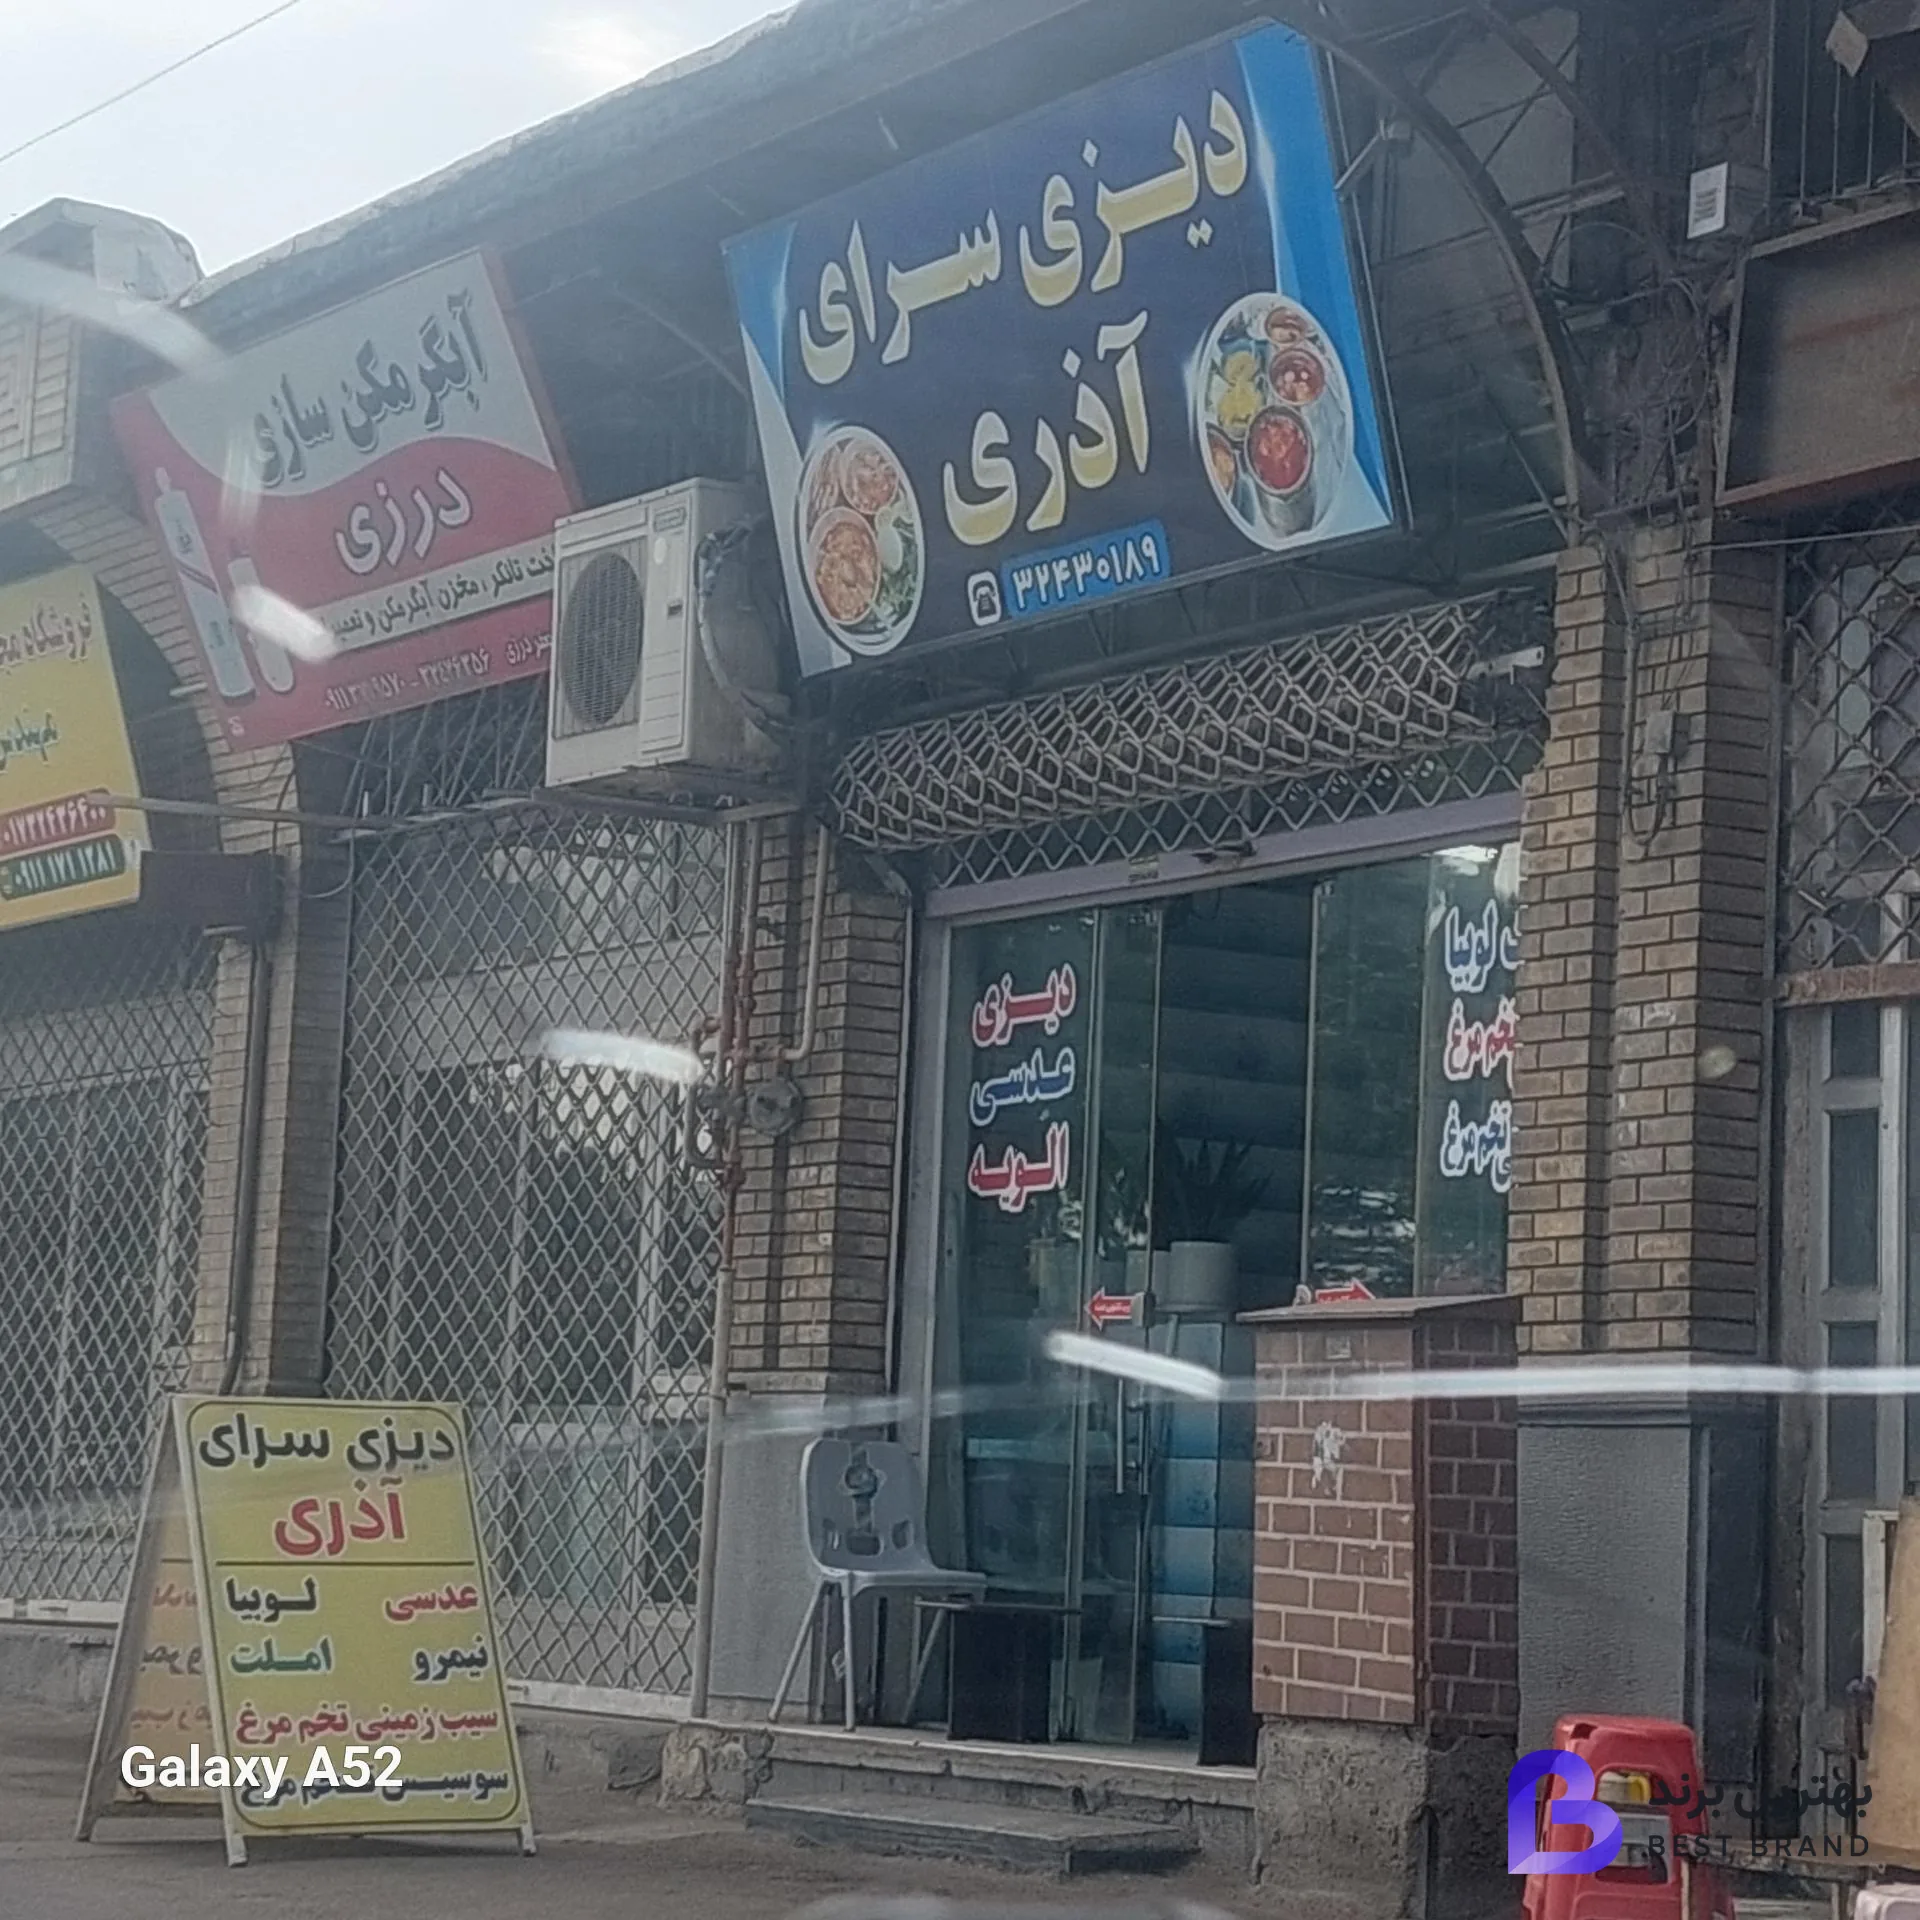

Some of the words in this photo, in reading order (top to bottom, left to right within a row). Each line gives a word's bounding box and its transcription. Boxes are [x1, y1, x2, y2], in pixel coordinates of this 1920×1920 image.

[1019, 89, 1248, 308] دیزی
[798, 208, 1001, 385] سرای
[253, 372, 334, 488] سازی
[943, 309, 1150, 546] آذری
[335, 467, 474, 576] درزی
[526, 542, 554, 578] اخت
[1011, 532, 1163, 610] ۳۲۴۳۰۱۸۹
[972, 963, 1077, 1047] دیزی
[970, 1047, 1076, 1126] عدسی
[968, 1121, 1069, 1213] الویه
[200, 1412, 331, 1470] سرای
[347, 1417, 457, 1473] دیزی
[275, 1476, 405, 1556] آذری
[225, 1576, 318, 1624] لوبیا
[385, 1585, 480, 1622] عدسی
[230, 1636, 332, 1675] املت
[413, 1635, 490, 1682] نیمرو
[236, 1700, 294, 1745] مرغ
[299, 1702, 349, 1744] تخم
[355, 1705, 435, 1742] زمینی
[439, 1710, 499, 1738] سیب
